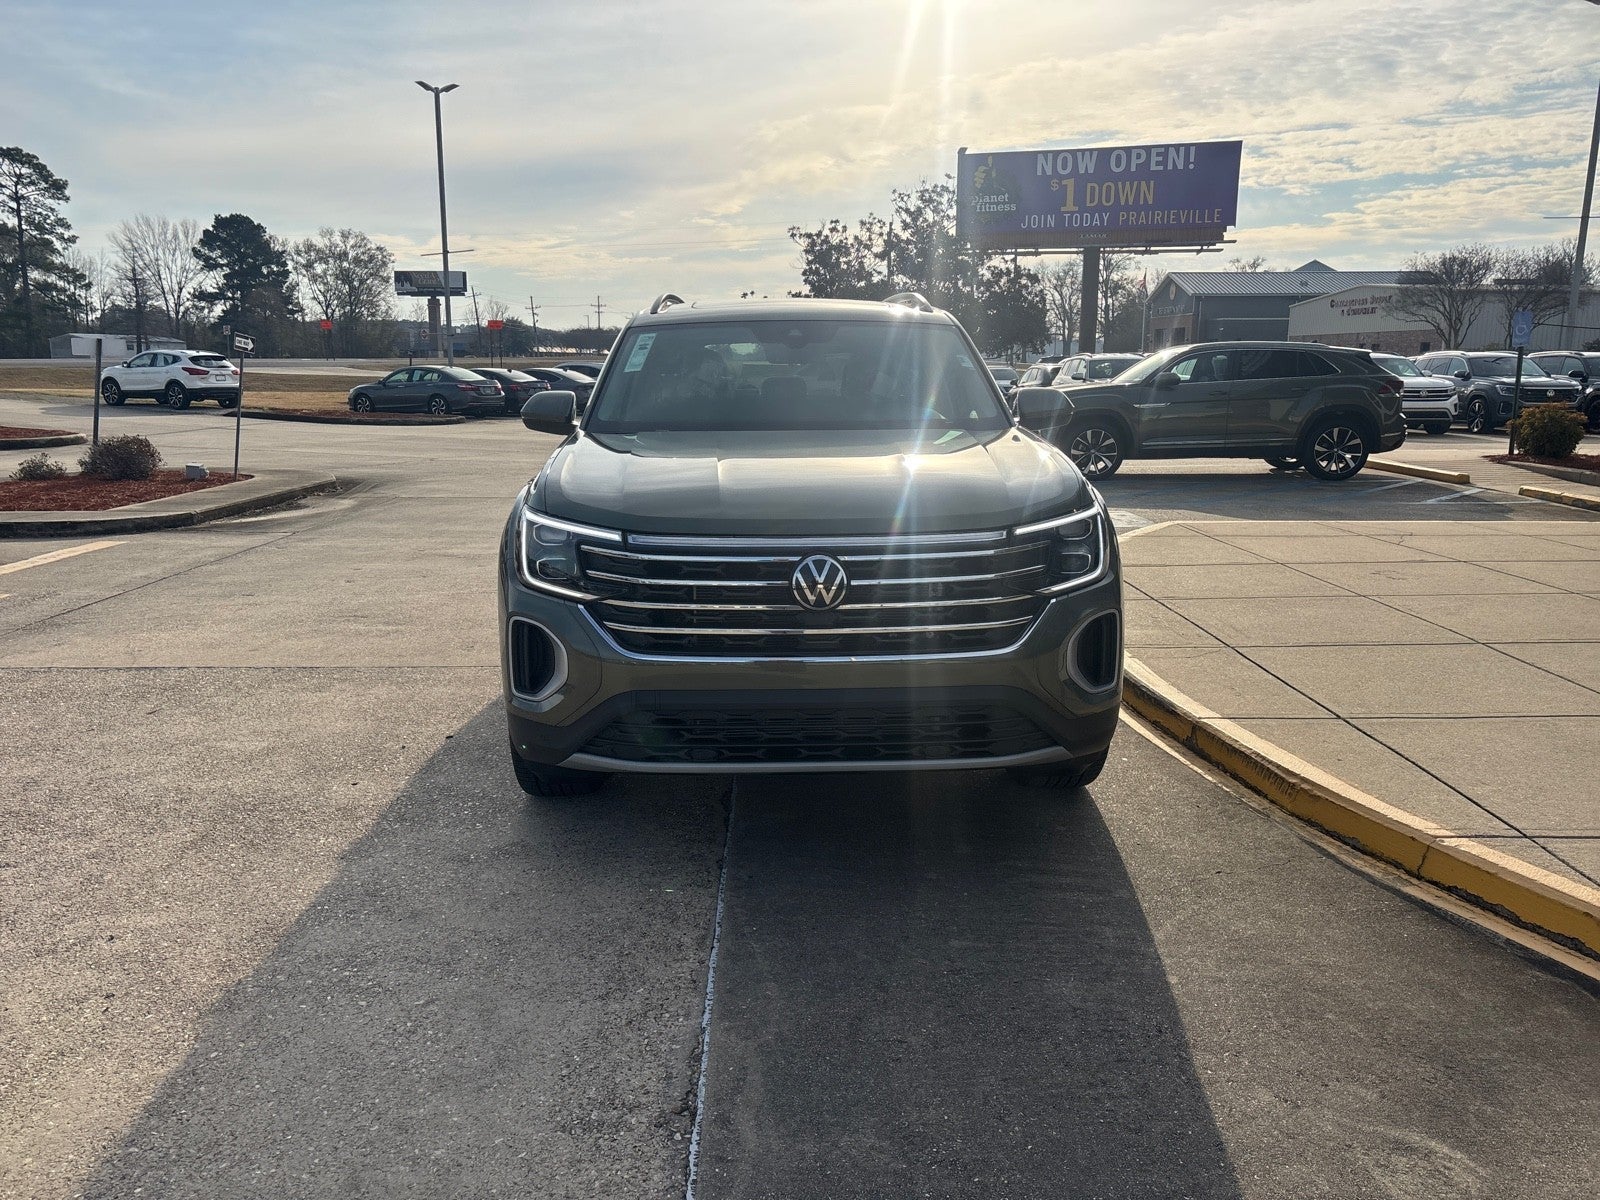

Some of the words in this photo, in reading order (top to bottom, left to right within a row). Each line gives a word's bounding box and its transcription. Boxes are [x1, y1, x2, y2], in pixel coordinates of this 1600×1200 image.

[1036, 151, 1098, 176] NOW
[1110, 146, 1197, 172] OPEN!
[971, 192, 1009, 206] planet
[1050, 177, 1079, 212] $1
[1086, 180, 1156, 207] DOWN
[976, 202, 1017, 212] fitness
[1021, 213, 1055, 229] JOIN
[1063, 212, 1110, 227] TODAY
[1119, 208, 1222, 226] PRAIRIEVILLE
